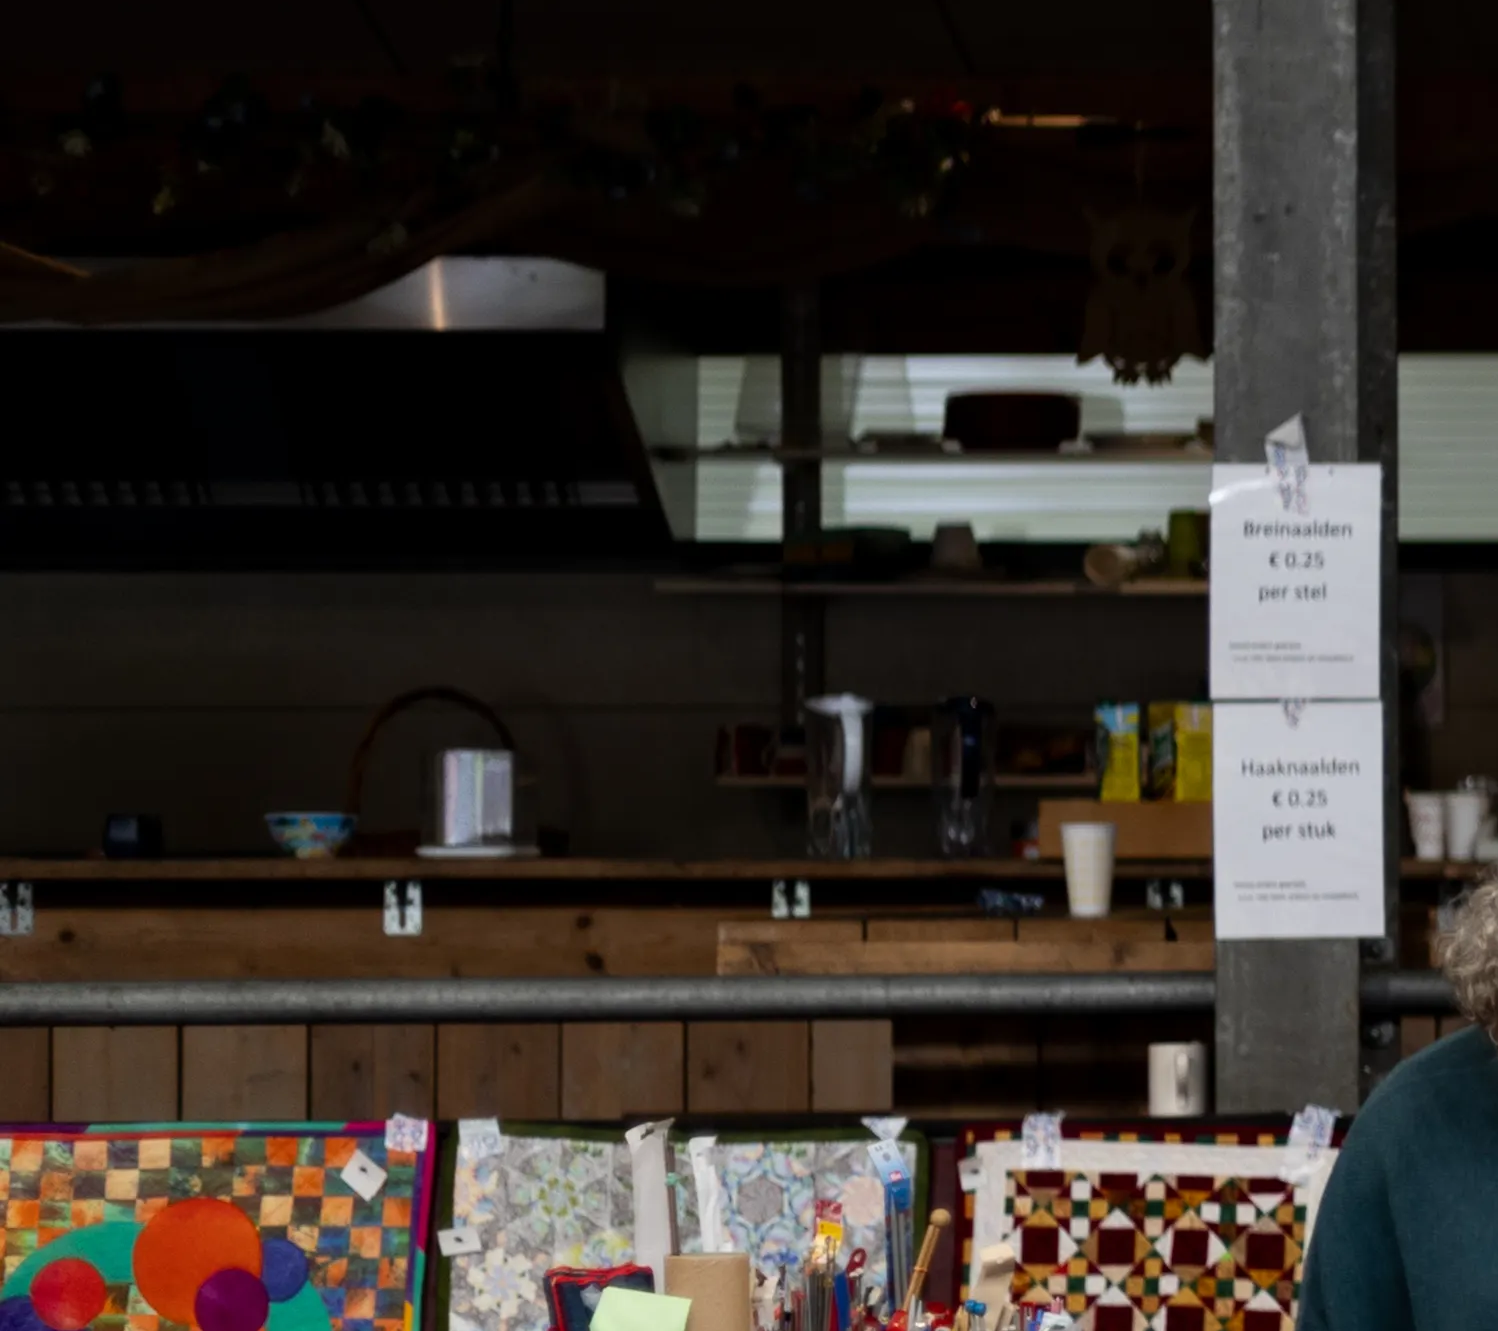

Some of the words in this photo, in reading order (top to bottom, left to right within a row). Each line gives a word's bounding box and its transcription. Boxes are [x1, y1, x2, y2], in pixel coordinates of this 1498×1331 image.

[1243, 517, 1352, 539] Breinaalden
[1268, 550, 1281, 569] €
[1285, 550, 1325, 570] 0.25
[1258, 584, 1288, 605] per
[1294, 581, 1328, 602] stel
[1241, 755, 1361, 778] Haaknaalden
[1271, 788, 1283, 809] €
[1287, 788, 1328, 809] 0.25
[1262, 824, 1292, 845] per
[1298, 820, 1336, 841] stuk
